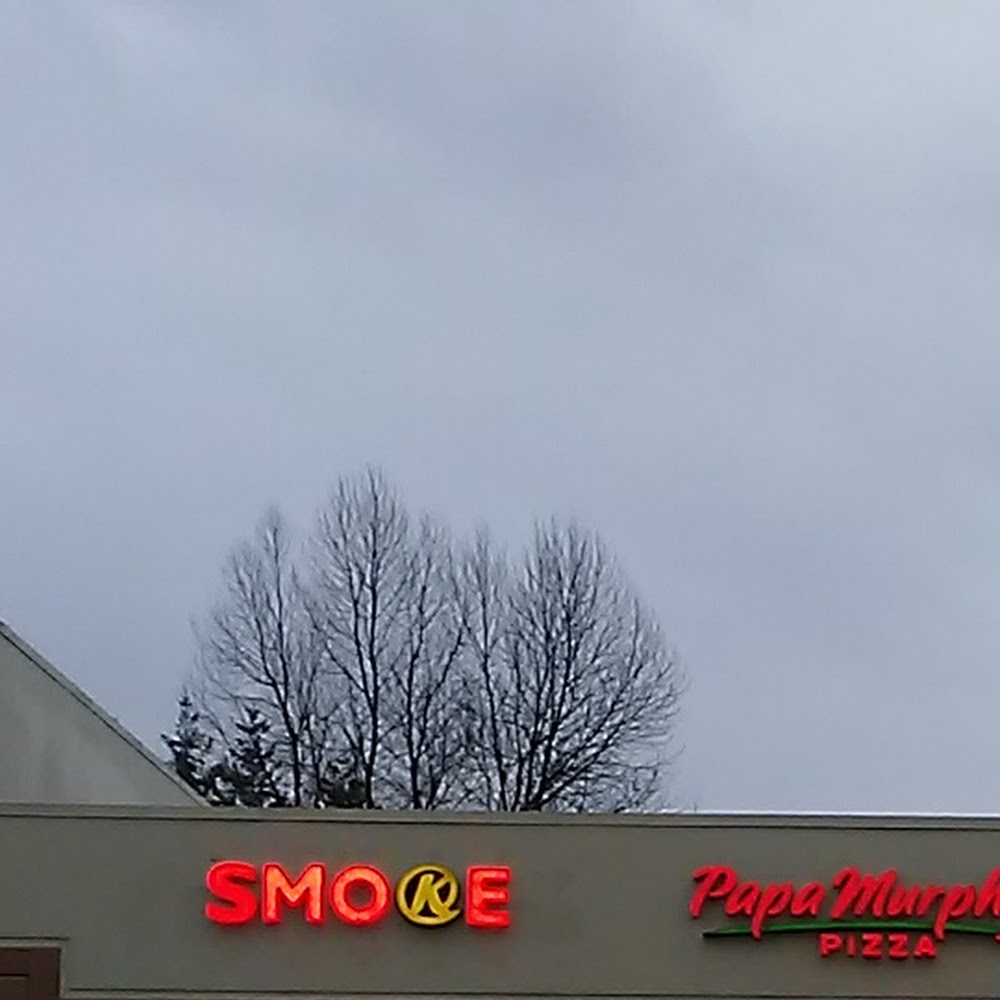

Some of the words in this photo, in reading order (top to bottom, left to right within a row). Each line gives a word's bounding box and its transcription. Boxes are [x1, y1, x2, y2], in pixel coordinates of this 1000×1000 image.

[204, 859, 513, 928] SMOKE
[690, 864, 826, 941] Papa
[818, 932, 938, 960] PIZZA
